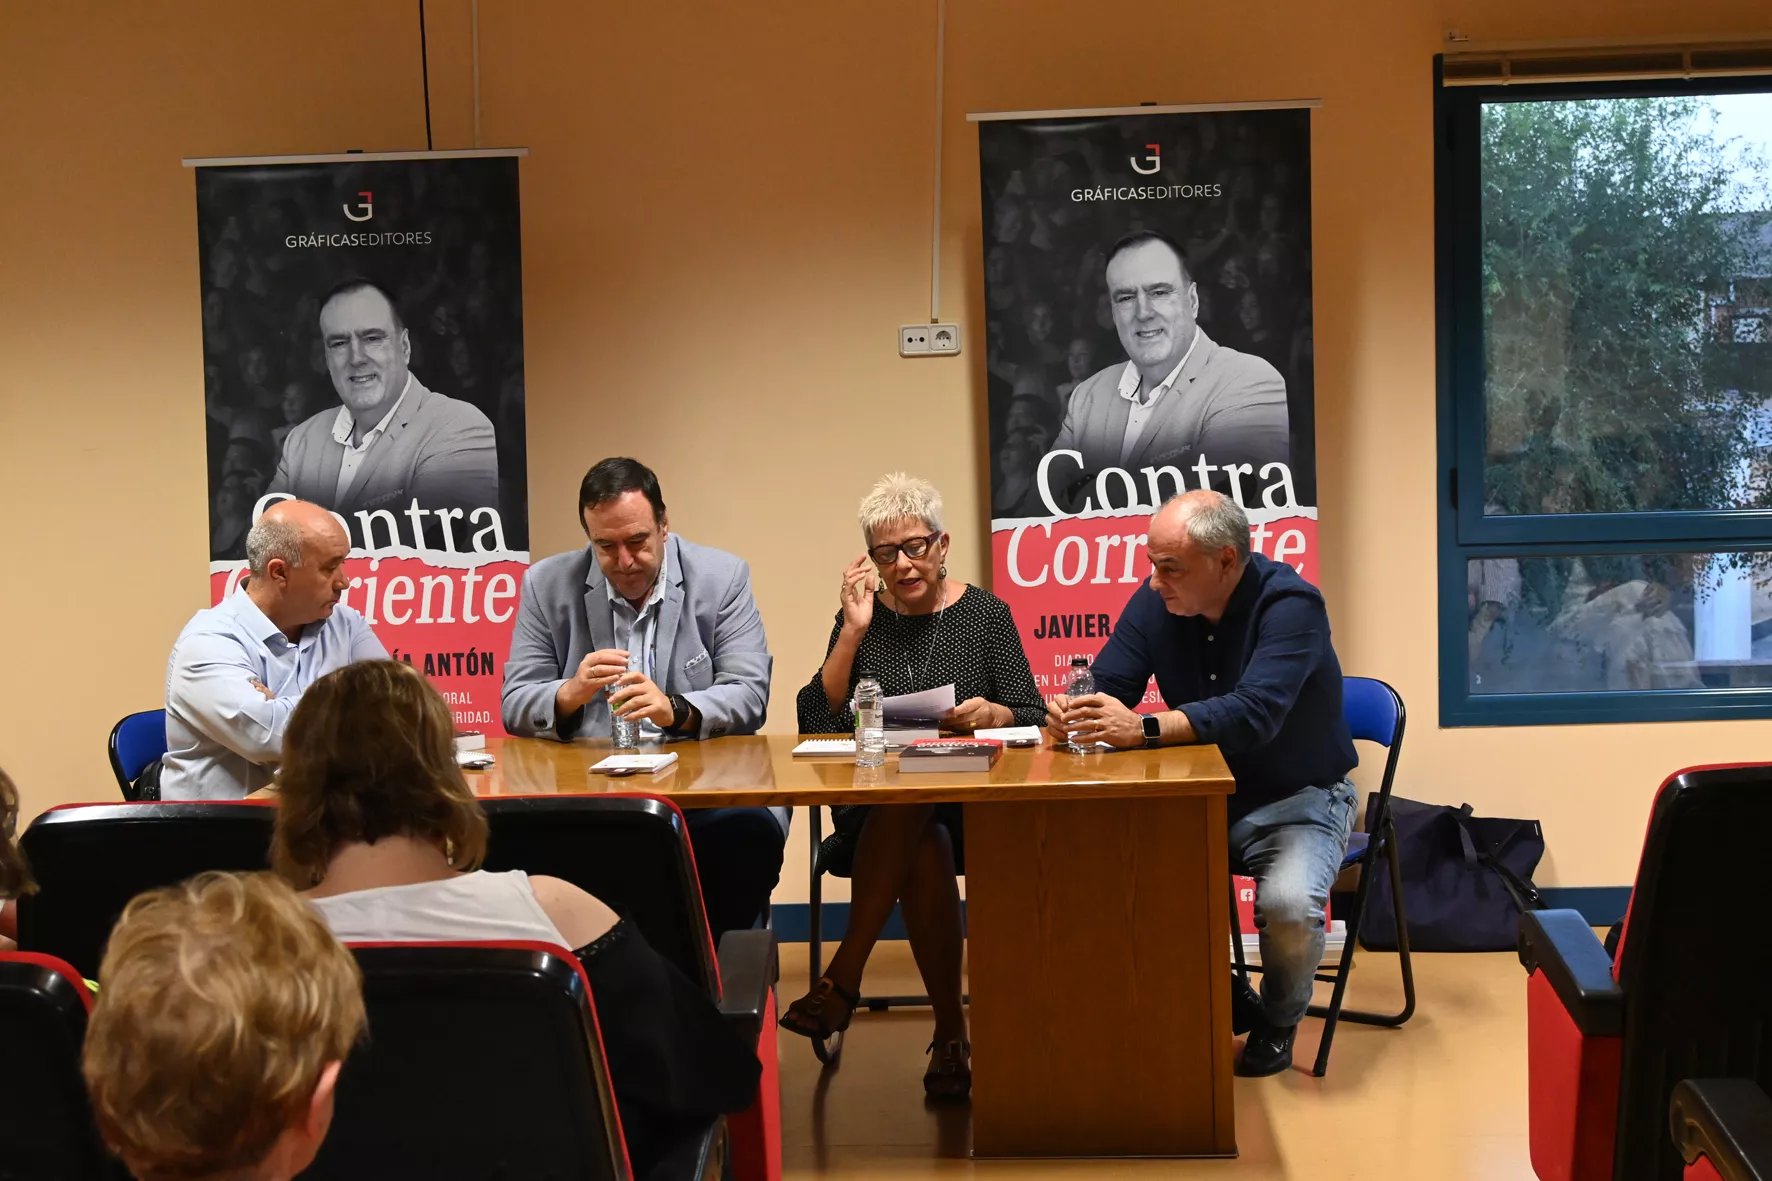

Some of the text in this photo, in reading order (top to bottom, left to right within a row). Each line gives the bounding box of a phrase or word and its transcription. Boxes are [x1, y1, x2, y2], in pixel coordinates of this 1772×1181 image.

[1071, 184, 1222, 202] GRÁFICASEDITORES
[285, 231, 432, 248] GRÁFICASEDITORES
[1037, 449, 1303, 517] Contra
[252, 493, 515, 552] ntra
[1007, 522, 1306, 587] Corrte
[223, 563, 517, 626] riente
[1033, 613, 1112, 639] JAVIER
[424, 647, 494, 676] ANTÓN
[441, 691, 473, 704] ORAL
